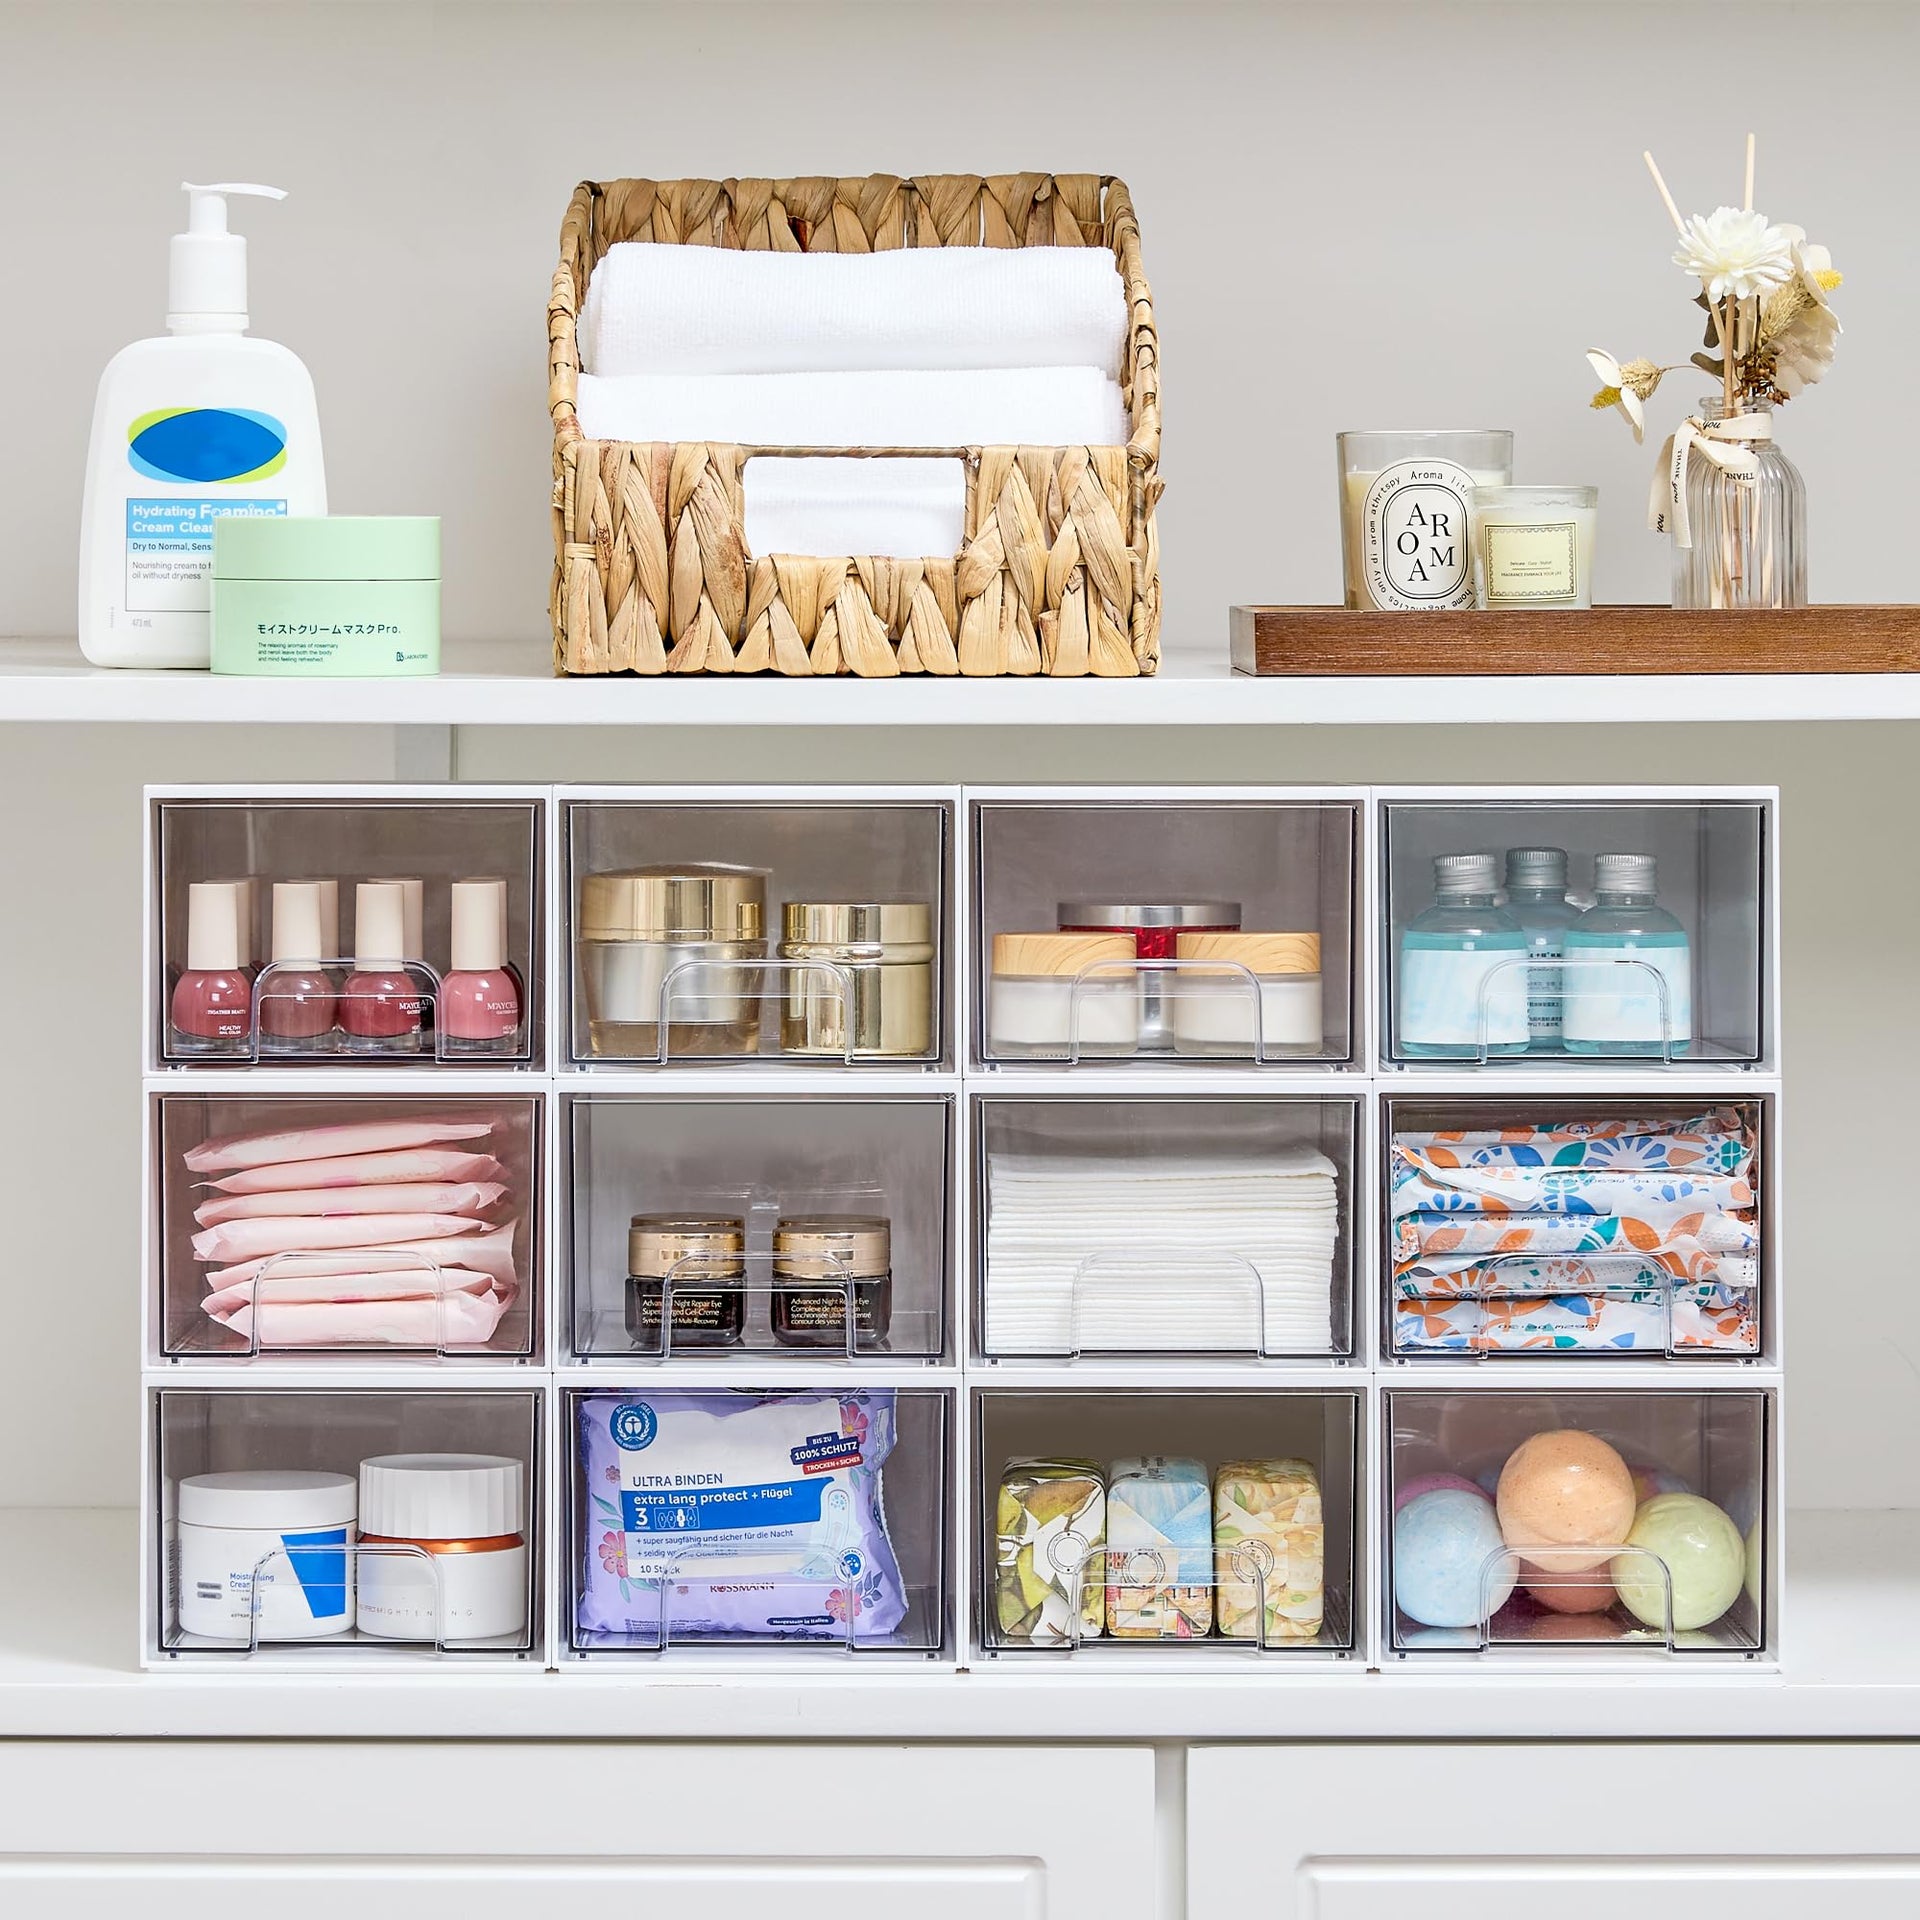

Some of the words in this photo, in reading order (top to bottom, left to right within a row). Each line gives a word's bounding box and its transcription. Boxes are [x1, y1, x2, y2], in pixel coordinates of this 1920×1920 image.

[1411, 471, 1443, 480] Aroma
[132, 504, 196, 519] Hydrating
[133, 522, 174, 533] Cream
[132, 543, 146, 552] Dry
[158, 542, 190, 551] Normal,
[132, 561, 172, 571] Nourishing
[171, 572, 201, 581] dryness
[674, 1300, 690, 1308] Night
[691, 1300, 710, 1308] Repair
[711, 1300, 722, 1308] Eye
[822, 1298, 838, 1306] Night
[794, 1449, 820, 1460] 100%
[821, 1441, 858, 1455] SCHUTZ
[806, 1461, 835, 1471] TROCKEN
[840, 1456, 860, 1465] SICHER
[633, 1476, 672, 1487] ULTRA
[675, 1473, 723, 1486] BINDEN
[634, 1494, 665, 1505] extra
[669, 1493, 697, 1506] lang
[700, 1490, 748, 1506] protect
[761, 1487, 793, 1499] Flügel
[635, 1507, 648, 1526] 3
[643, 1537, 663, 1545] super
[665, 1534, 701, 1546] saugfähig
[703, 1534, 718, 1542] und
[720, 1532, 742, 1541] sicher
[744, 1532, 755, 1540] für
[756, 1531, 768, 1539] die
[770, 1529, 794, 1538] Nacht
[641, 1565, 651, 1573] 10
[654, 1565, 681, 1574] Stck
